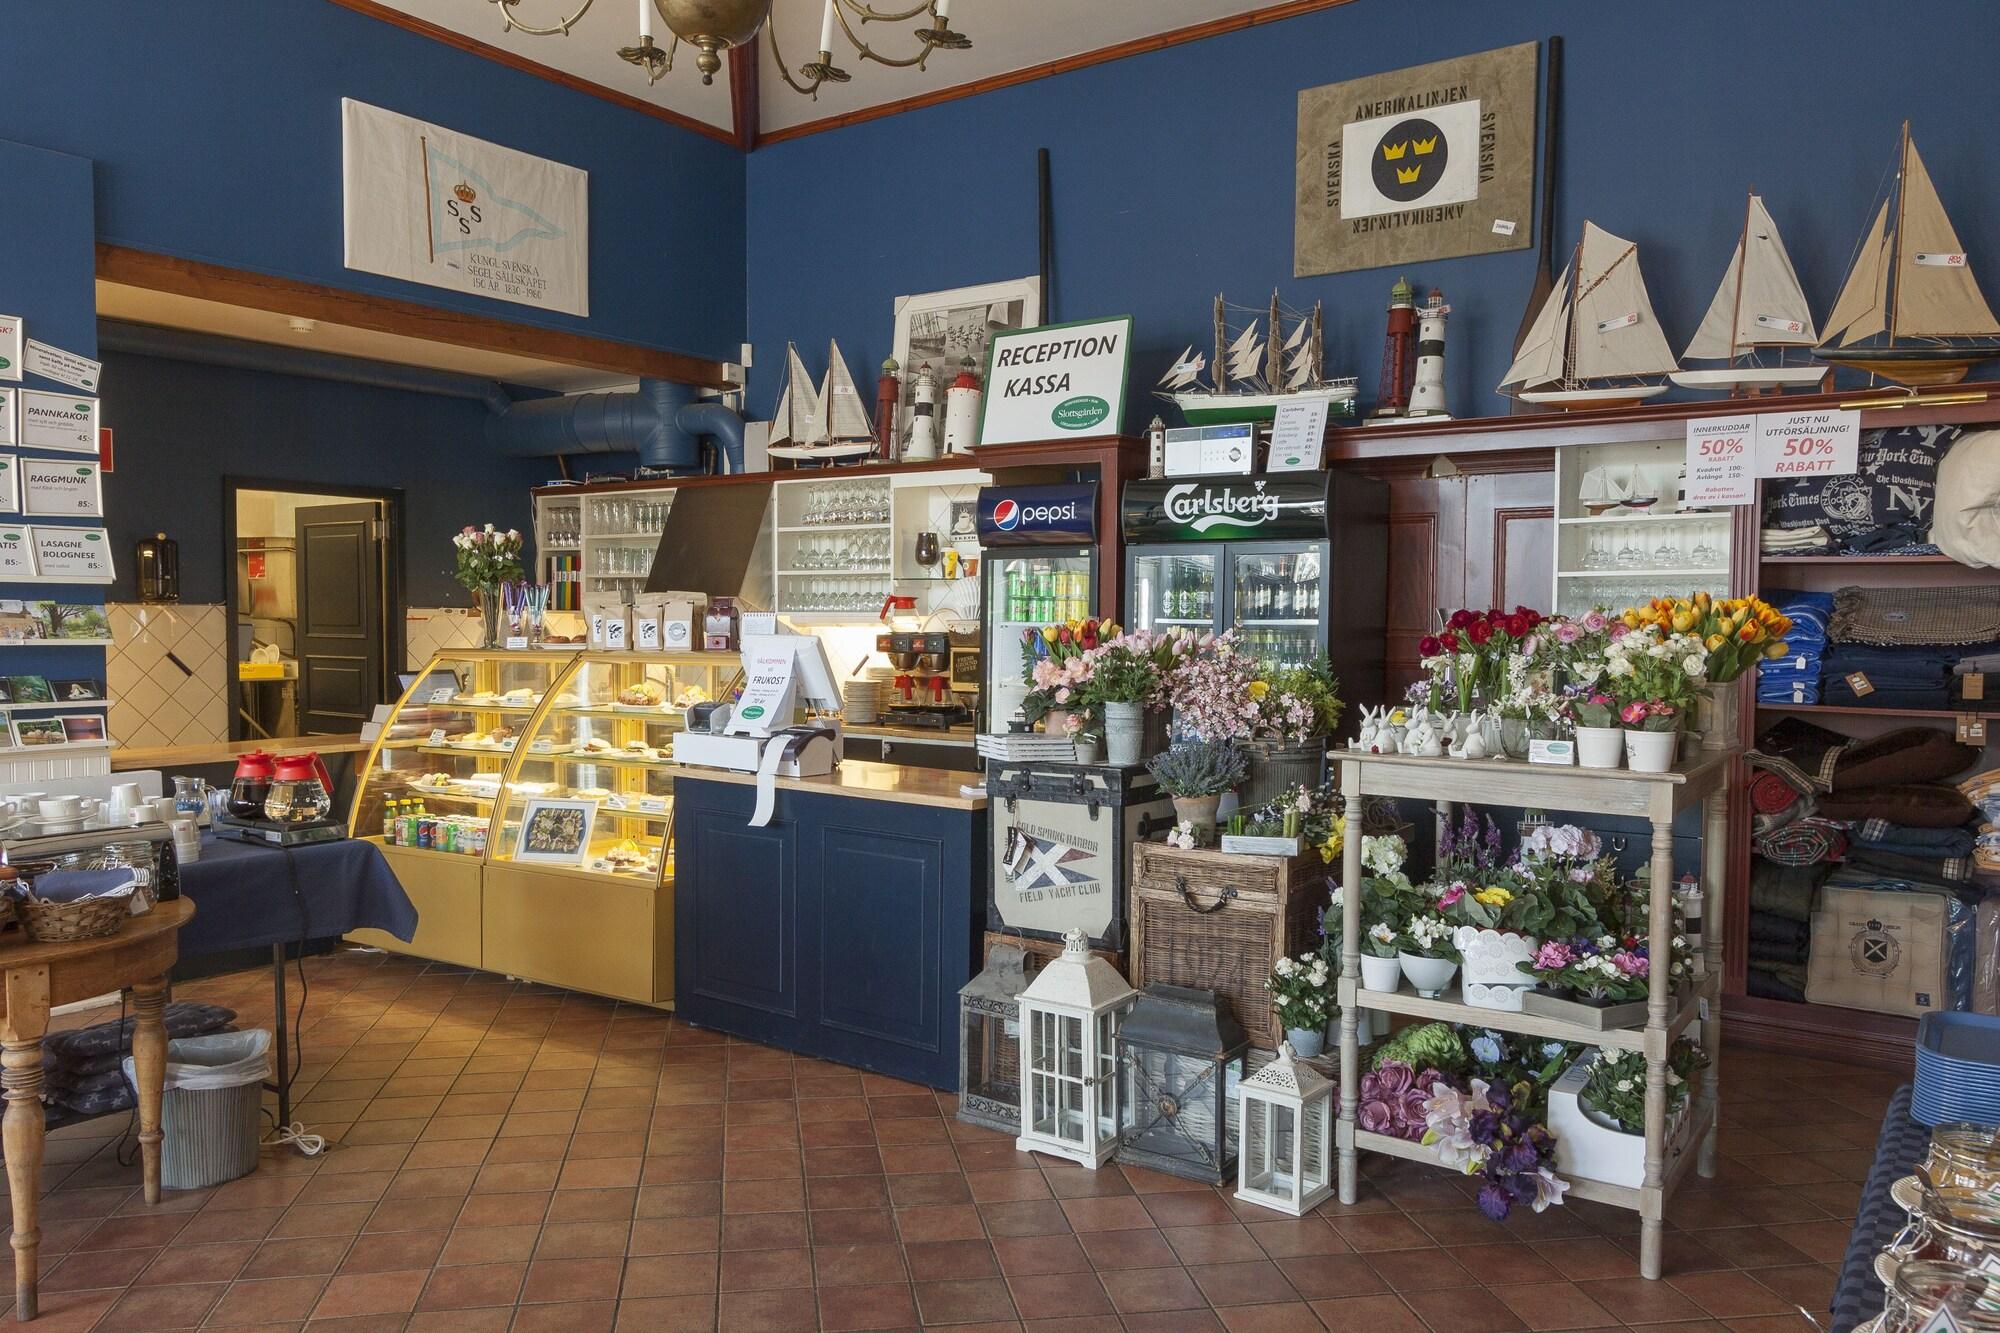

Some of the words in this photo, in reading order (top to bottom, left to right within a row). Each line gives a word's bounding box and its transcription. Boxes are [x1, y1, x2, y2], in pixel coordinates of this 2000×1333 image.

[1355, 85, 1469, 121] AMERIKALINJEN
[1480, 112, 1496, 184] SVENSKA
[1327, 140, 1341, 207] SVENSKA
[447, 199, 459, 217] S
[470, 205, 482, 223] S
[1352, 204, 1465, 234] AMERIKALINJEN
[458, 217, 471, 235] S
[467, 264, 494, 280] SEGEL
[501, 260, 540, 277] SVENSKA
[996, 334, 1118, 368] RECEPTION
[1003, 372, 1070, 398] KASSA
[27, 407, 89, 421] PANNKAKOR
[1788, 416, 1812, 425] JUST
[1813, 415, 1830, 424] NU
[1693, 423, 1751, 434] INNERKUDDAR
[1766, 424, 1850, 437] UTFÖRSÄLJNING!
[1699, 437, 1744, 456] 50%
[1783, 437, 1834, 457] 50%
[1875, 447, 1909, 466] York
[1696, 465, 1722, 473] Kvadrat
[1775, 459, 1836, 473] RABATT
[30, 474, 88, 484] RAGGMUNK
[1875, 474, 1890, 484] The
[1163, 483, 1281, 525] Carlsberg
[1788, 491, 1820, 508] Times
[1886, 484, 1934, 520] NY
[1022, 501, 1075, 526] pepsi
[1815, 517, 1831, 528] Post
[40, 540, 83, 549] LASAGNE
[42, 551, 96, 560] BOLOGNESE
[752, 675, 786, 685] FRUKOST
[1037, 826, 1066, 844] SPRING
[1066, 834, 1099, 852] HARBOR
[1019, 889, 1044, 904] FIELD
[1048, 886, 1076, 901] YACHT
[1078, 883, 1101, 896] CLUB
